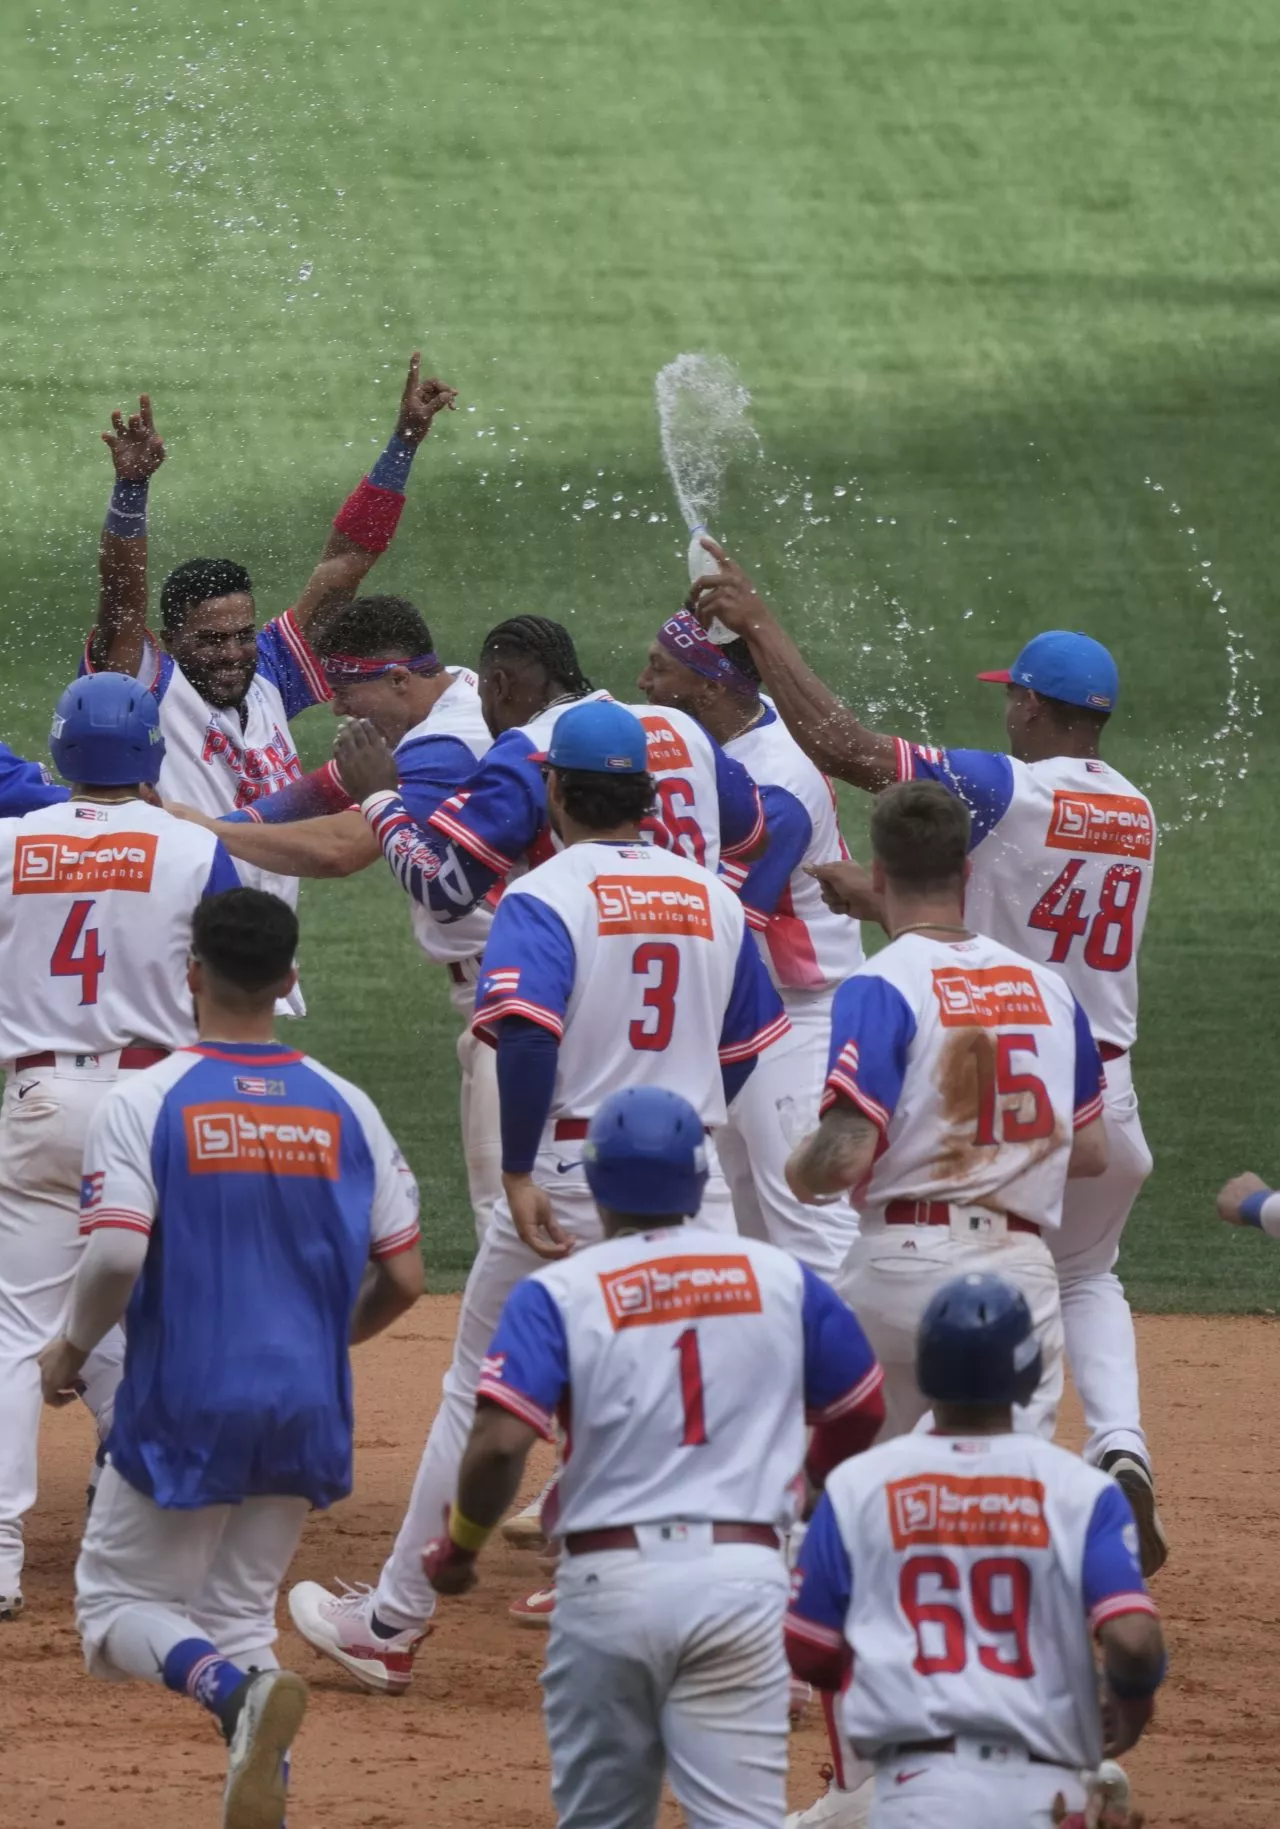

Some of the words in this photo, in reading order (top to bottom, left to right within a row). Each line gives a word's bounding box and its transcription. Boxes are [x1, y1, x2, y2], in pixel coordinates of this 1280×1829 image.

[1088, 803, 1150, 830] brava
[60, 844, 147, 865] brava
[59, 867, 144, 881] lubricants
[627, 886, 706, 911] brava
[1027, 858, 1142, 972] 48
[632, 910, 709, 927] lubricants
[50, 900, 106, 1006] 4
[629, 942, 680, 1052] 3
[268, 1079, 287, 1096] 21
[971, 1033, 1056, 1147] 15
[237, 1114, 332, 1148] brava
[650, 1267, 748, 1292] brava
[671, 1326, 711, 1447] 1
[939, 1485, 1041, 1518] brava
[899, 1555, 1036, 1680] 69
